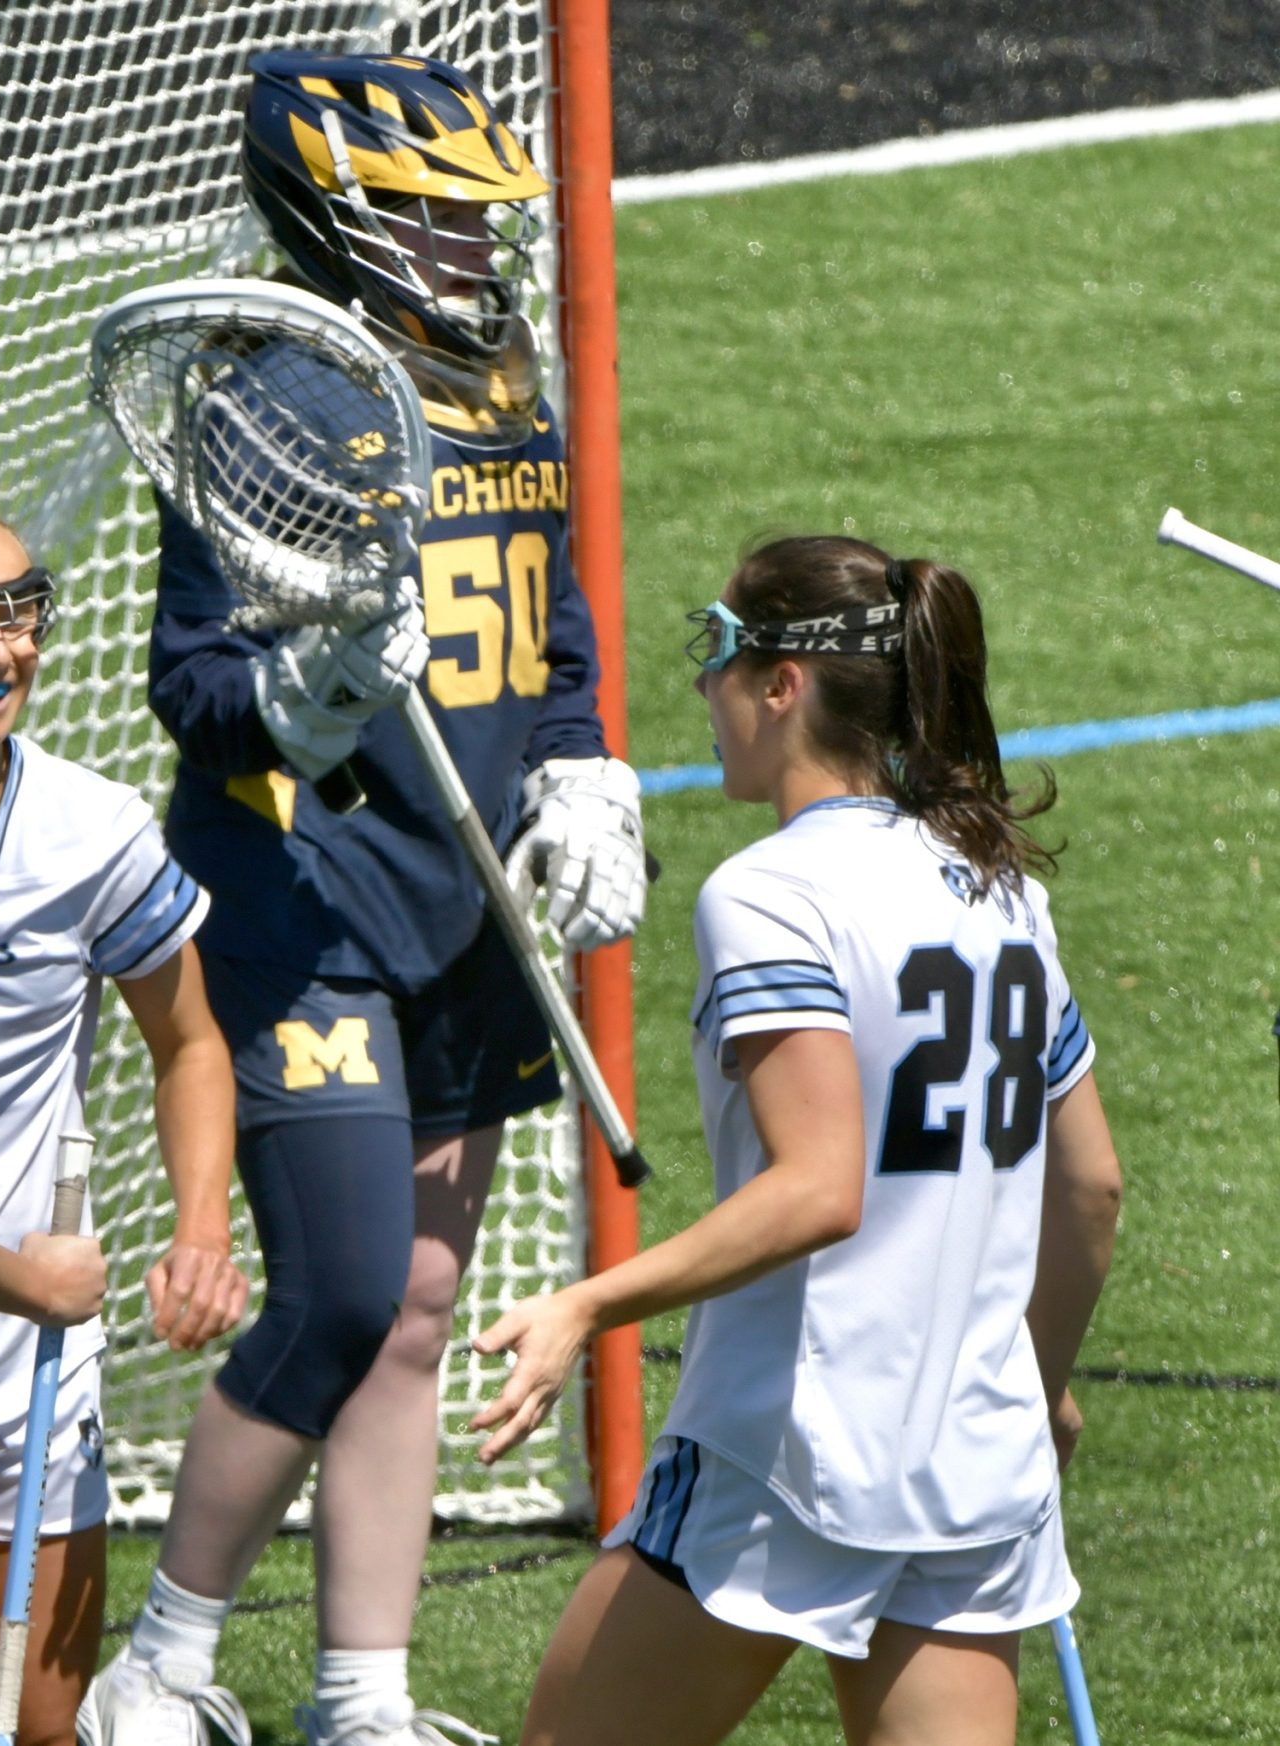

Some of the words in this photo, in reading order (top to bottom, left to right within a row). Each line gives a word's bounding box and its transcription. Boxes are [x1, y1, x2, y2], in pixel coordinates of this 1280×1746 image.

[424, 461, 569, 521] CHIGA
[420, 532, 550, 709] 50
[786, 613, 848, 634] STX
[865, 602, 901, 626] ST
[274, 1016, 381, 1091] M
[874, 938, 1049, 1178] 28
